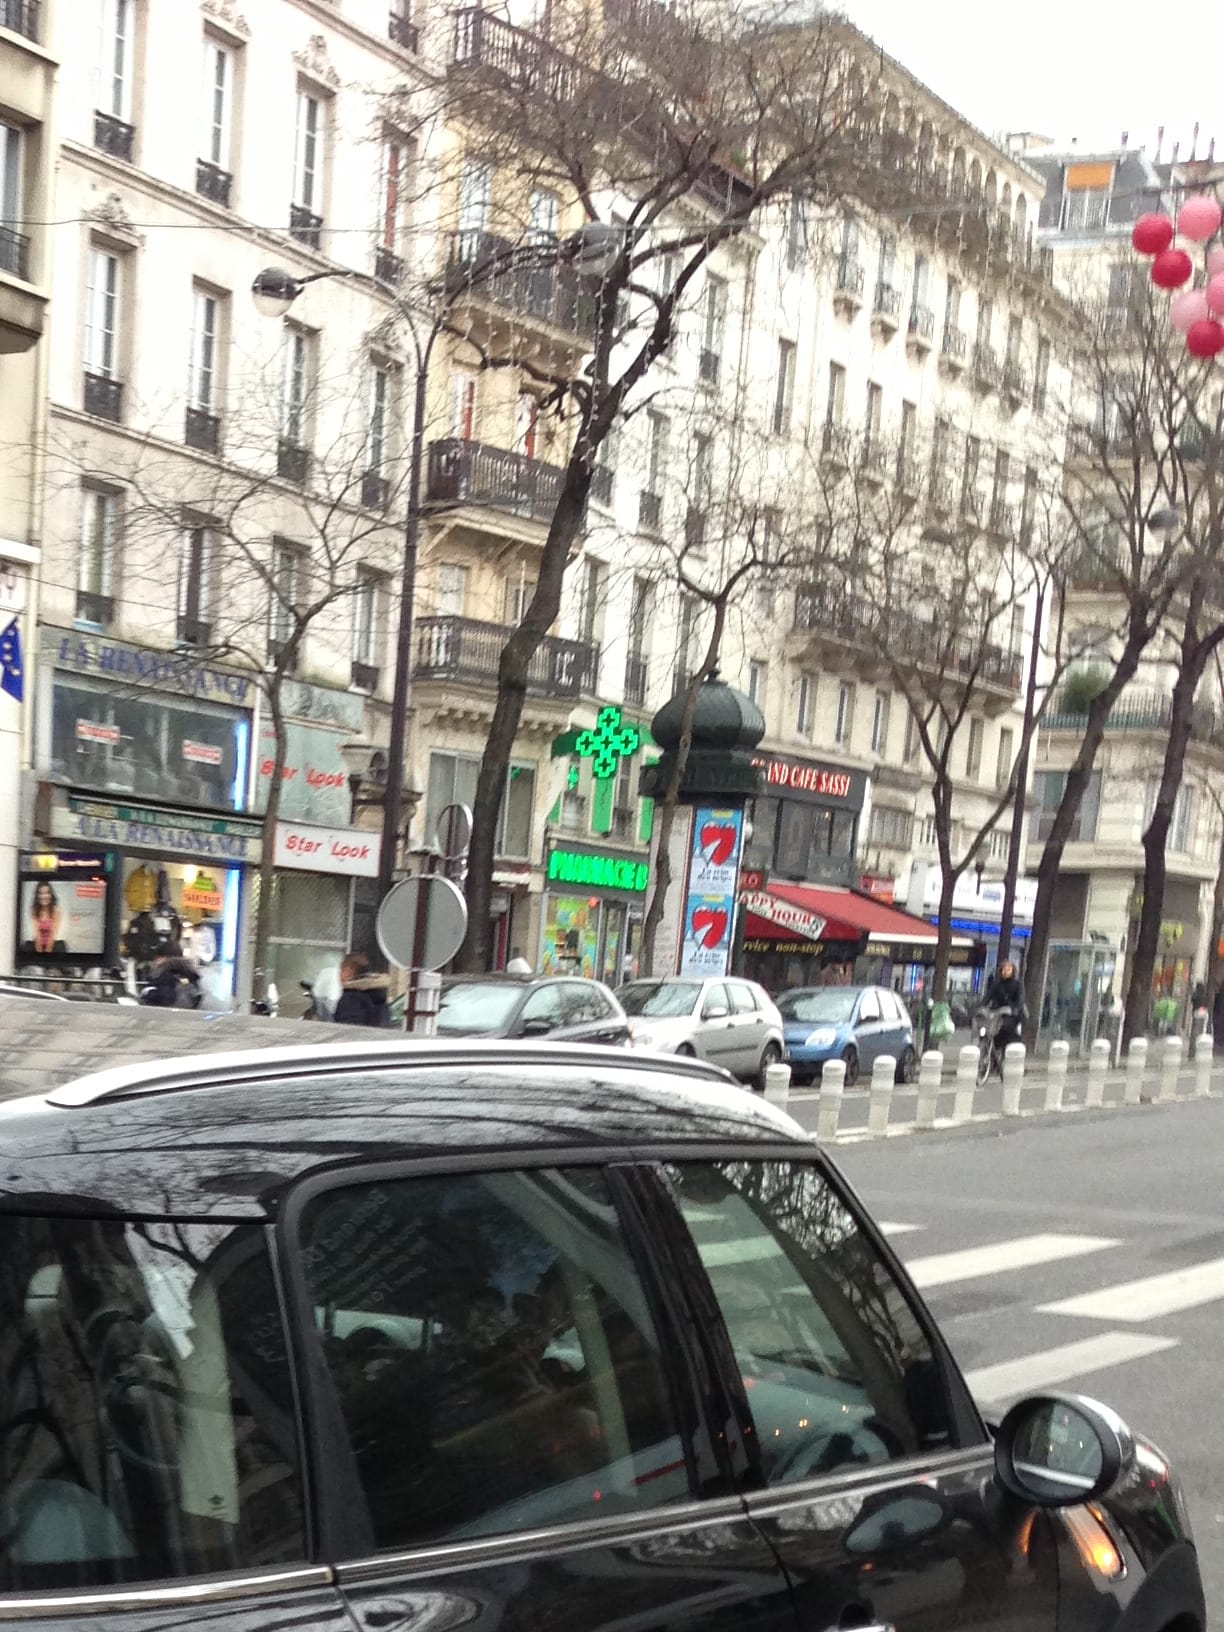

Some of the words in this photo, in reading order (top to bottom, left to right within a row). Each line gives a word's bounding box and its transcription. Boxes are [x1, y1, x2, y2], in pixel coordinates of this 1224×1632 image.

[260, 758, 298, 780] Sar
[305, 766, 346, 789] Look
[790, 764, 819, 793] CAFE
[285, 834, 323, 855] Star
[331, 840, 371, 862] Look
[549, 850, 635, 890] PHARMACIE
[738, 893, 777, 909] APPY
